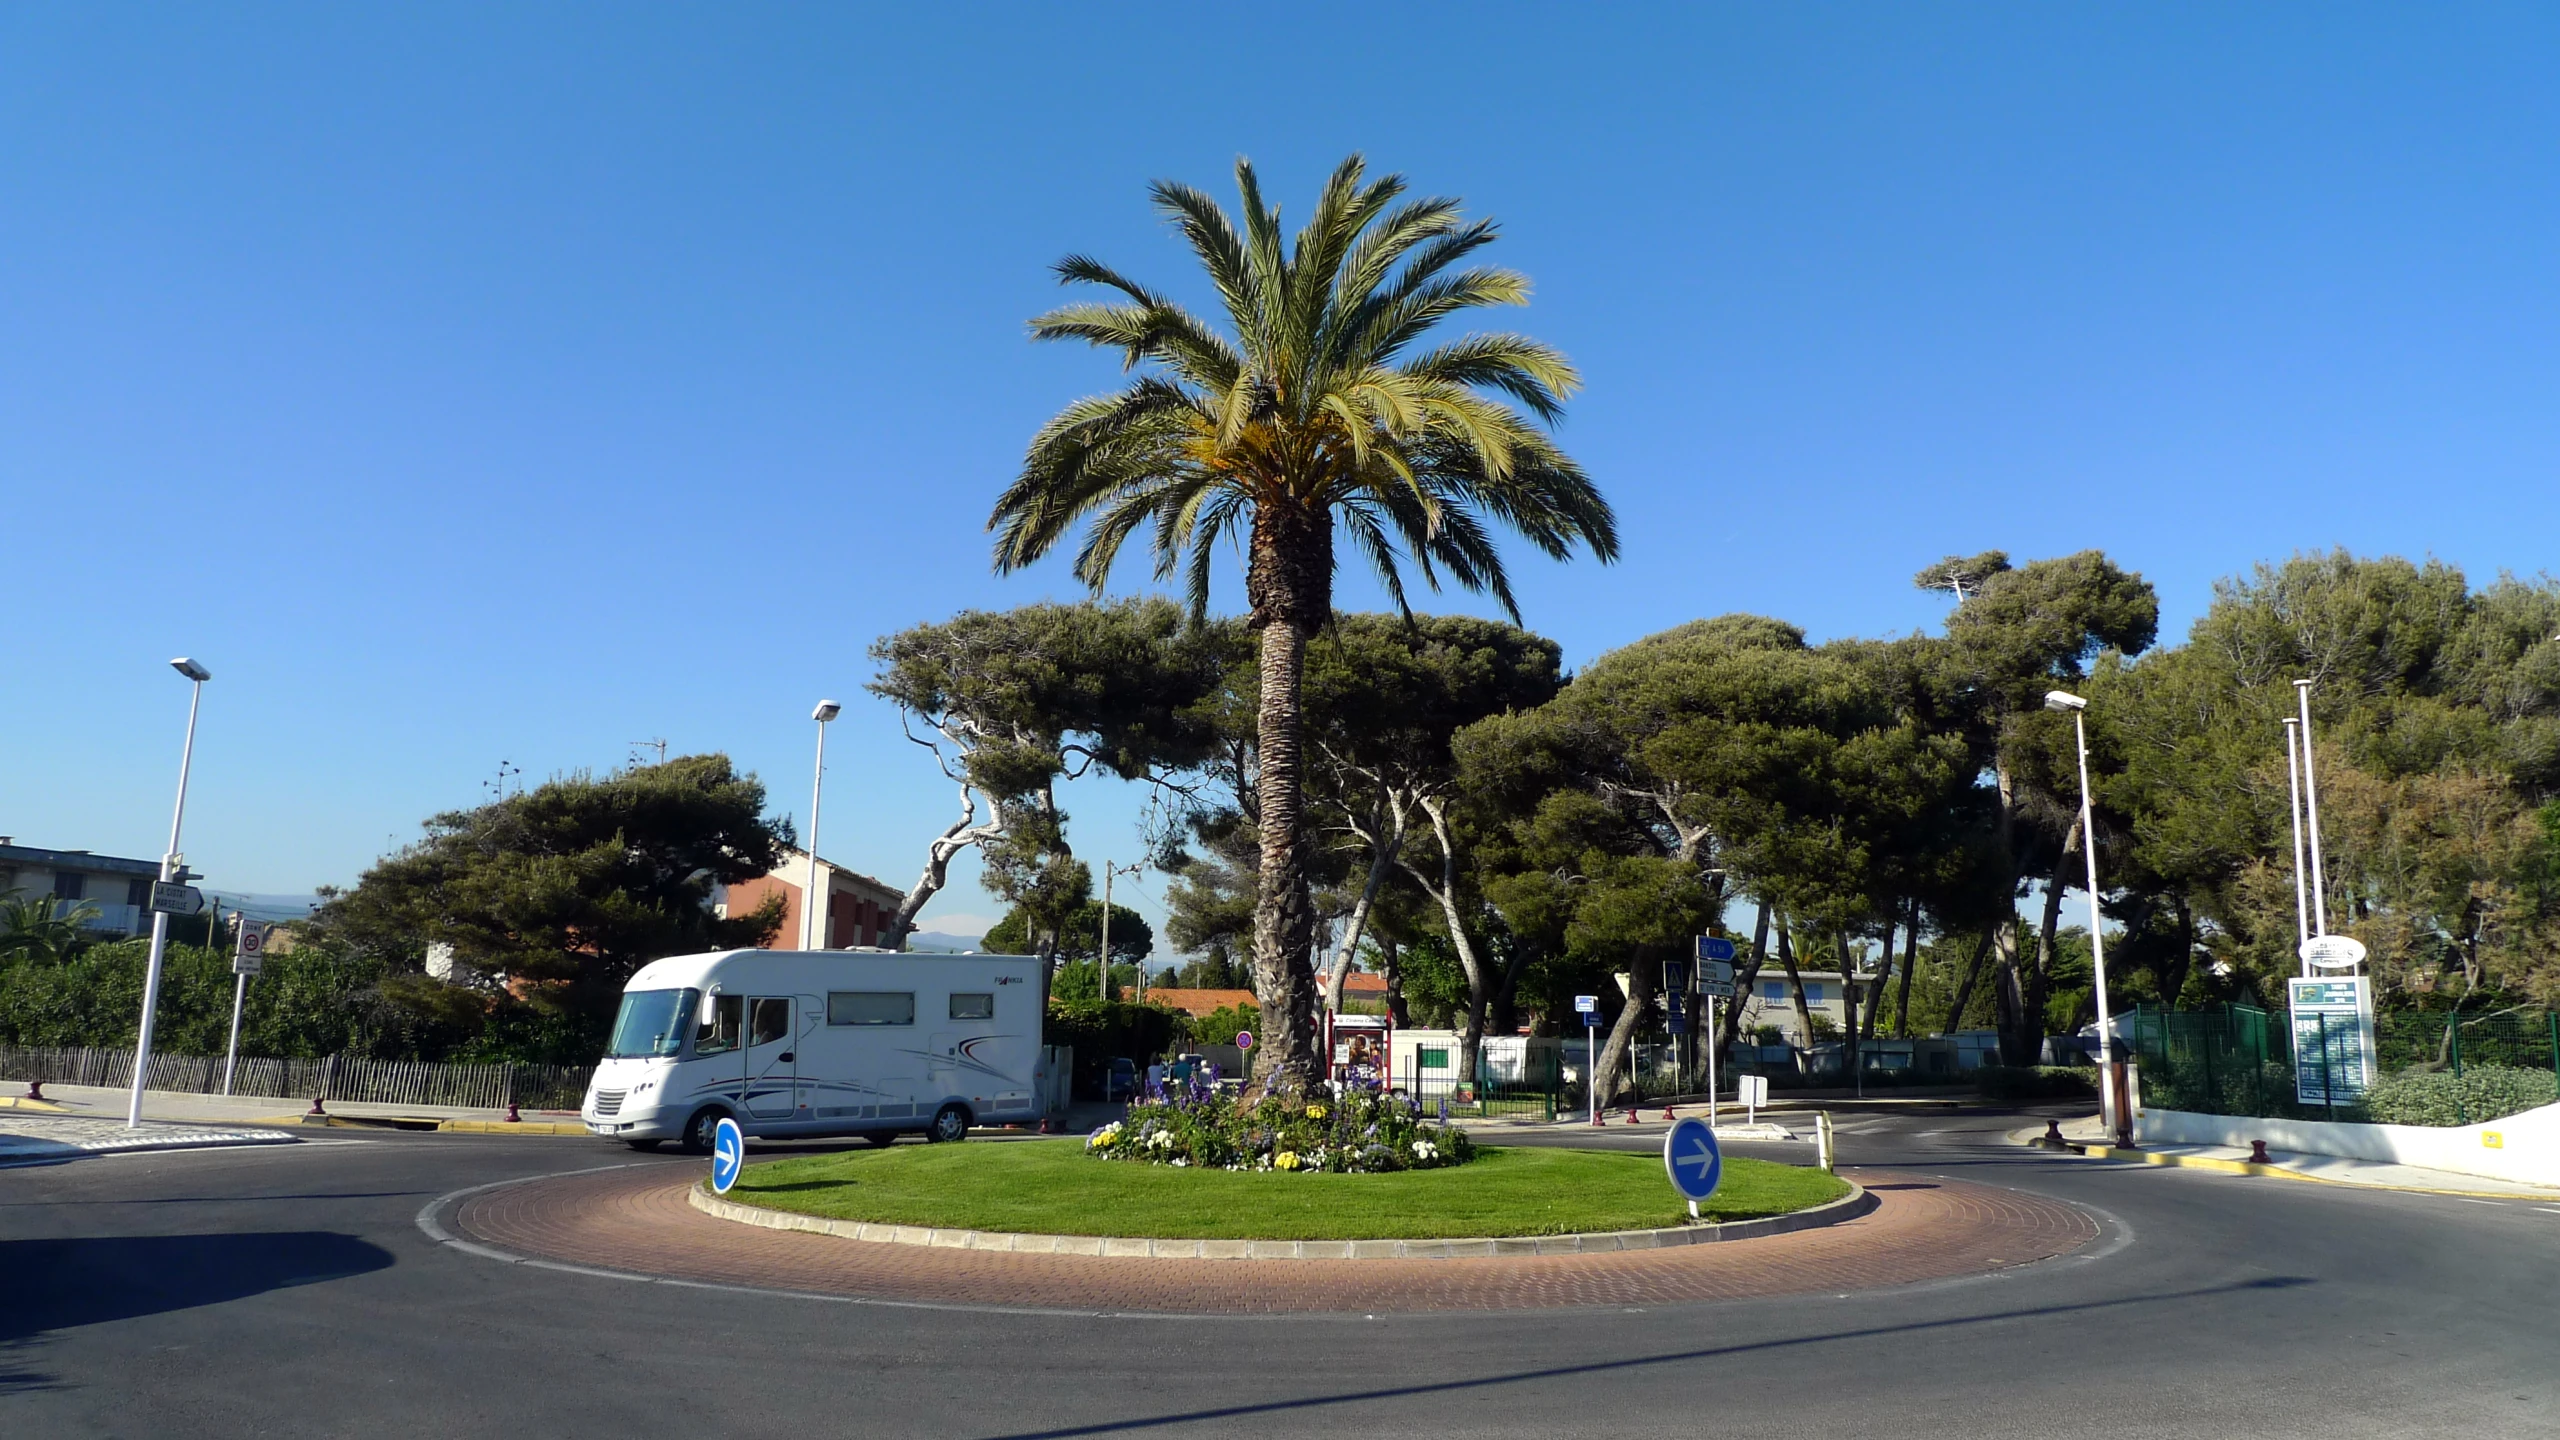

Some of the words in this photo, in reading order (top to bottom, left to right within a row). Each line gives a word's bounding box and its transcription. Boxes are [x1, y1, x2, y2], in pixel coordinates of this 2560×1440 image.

[156, 898, 188, 911] MARSEILLE
[1700, 961, 1717, 970] BANDOL
[994, 976, 1024, 985] FRANKIA
